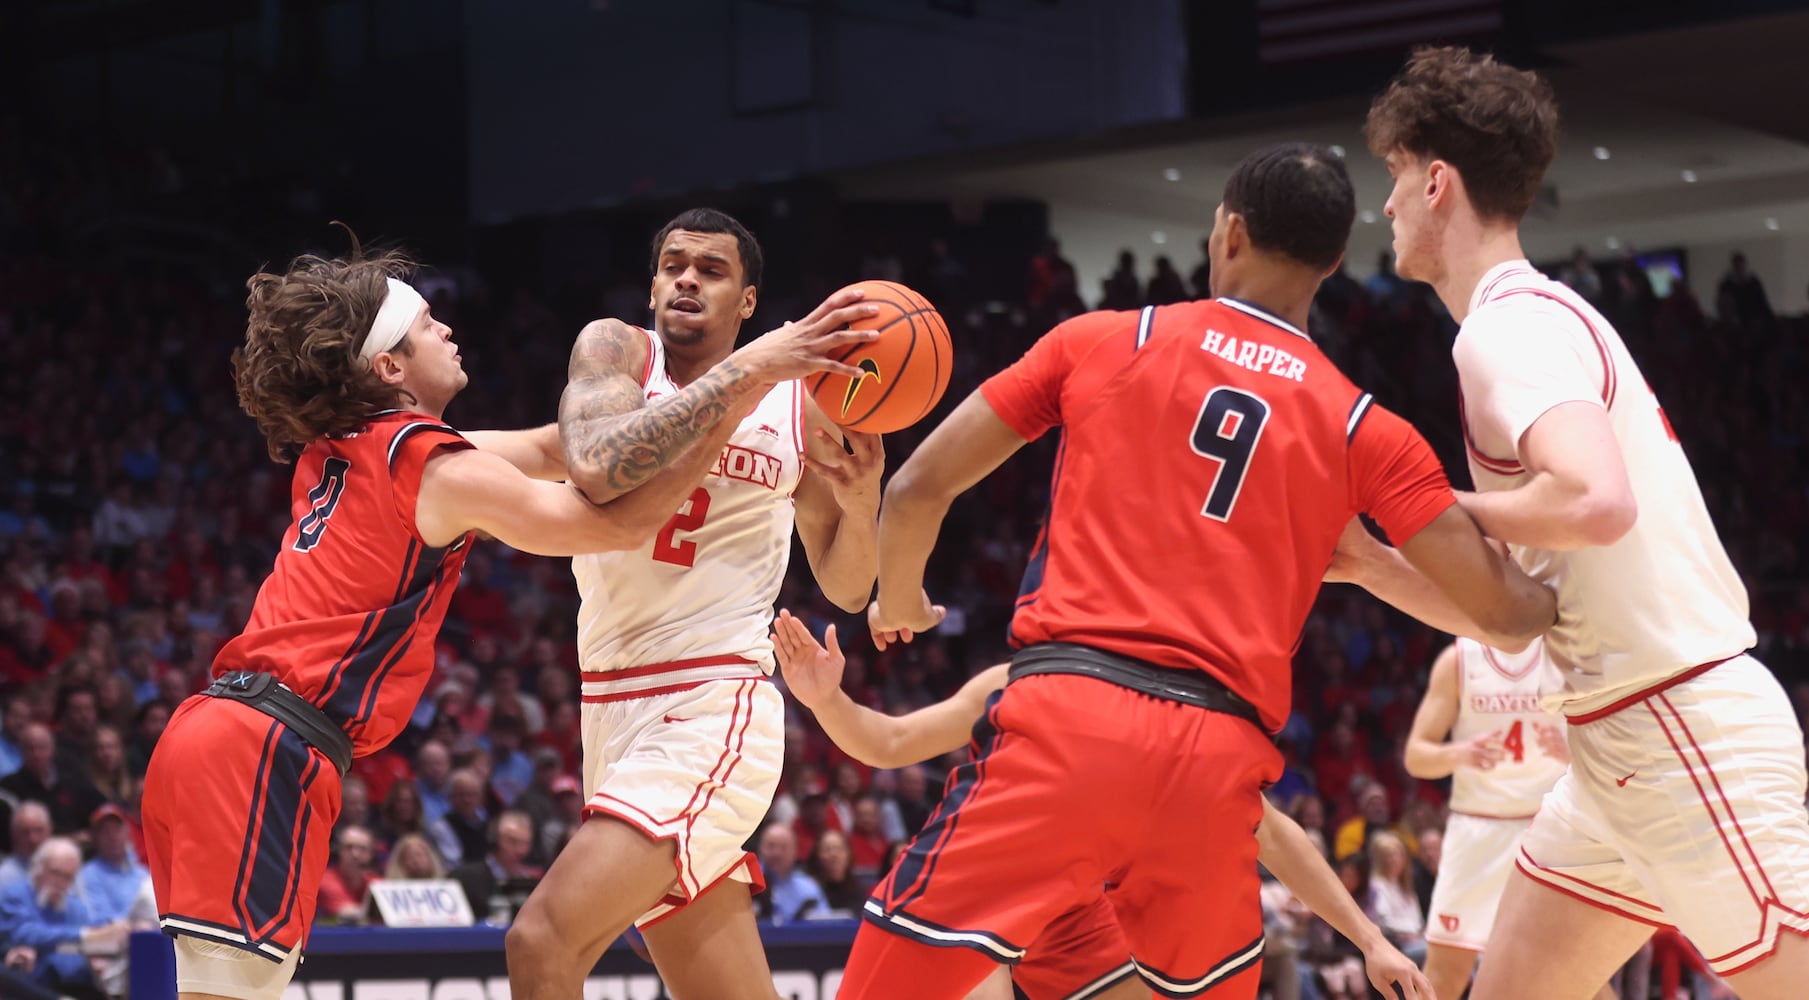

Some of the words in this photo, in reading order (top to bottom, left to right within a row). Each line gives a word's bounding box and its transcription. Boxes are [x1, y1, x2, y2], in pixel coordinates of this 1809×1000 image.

[1200, 329, 1307, 382] HARPER
[708, 442, 782, 491] TON
[1189, 385, 1271, 523] 9
[292, 456, 350, 553] 0
[652, 486, 711, 568] 2
[1471, 692, 1543, 713] DAYTO
[1503, 719, 1525, 764] 4
[383, 888, 459, 915] WHIO
